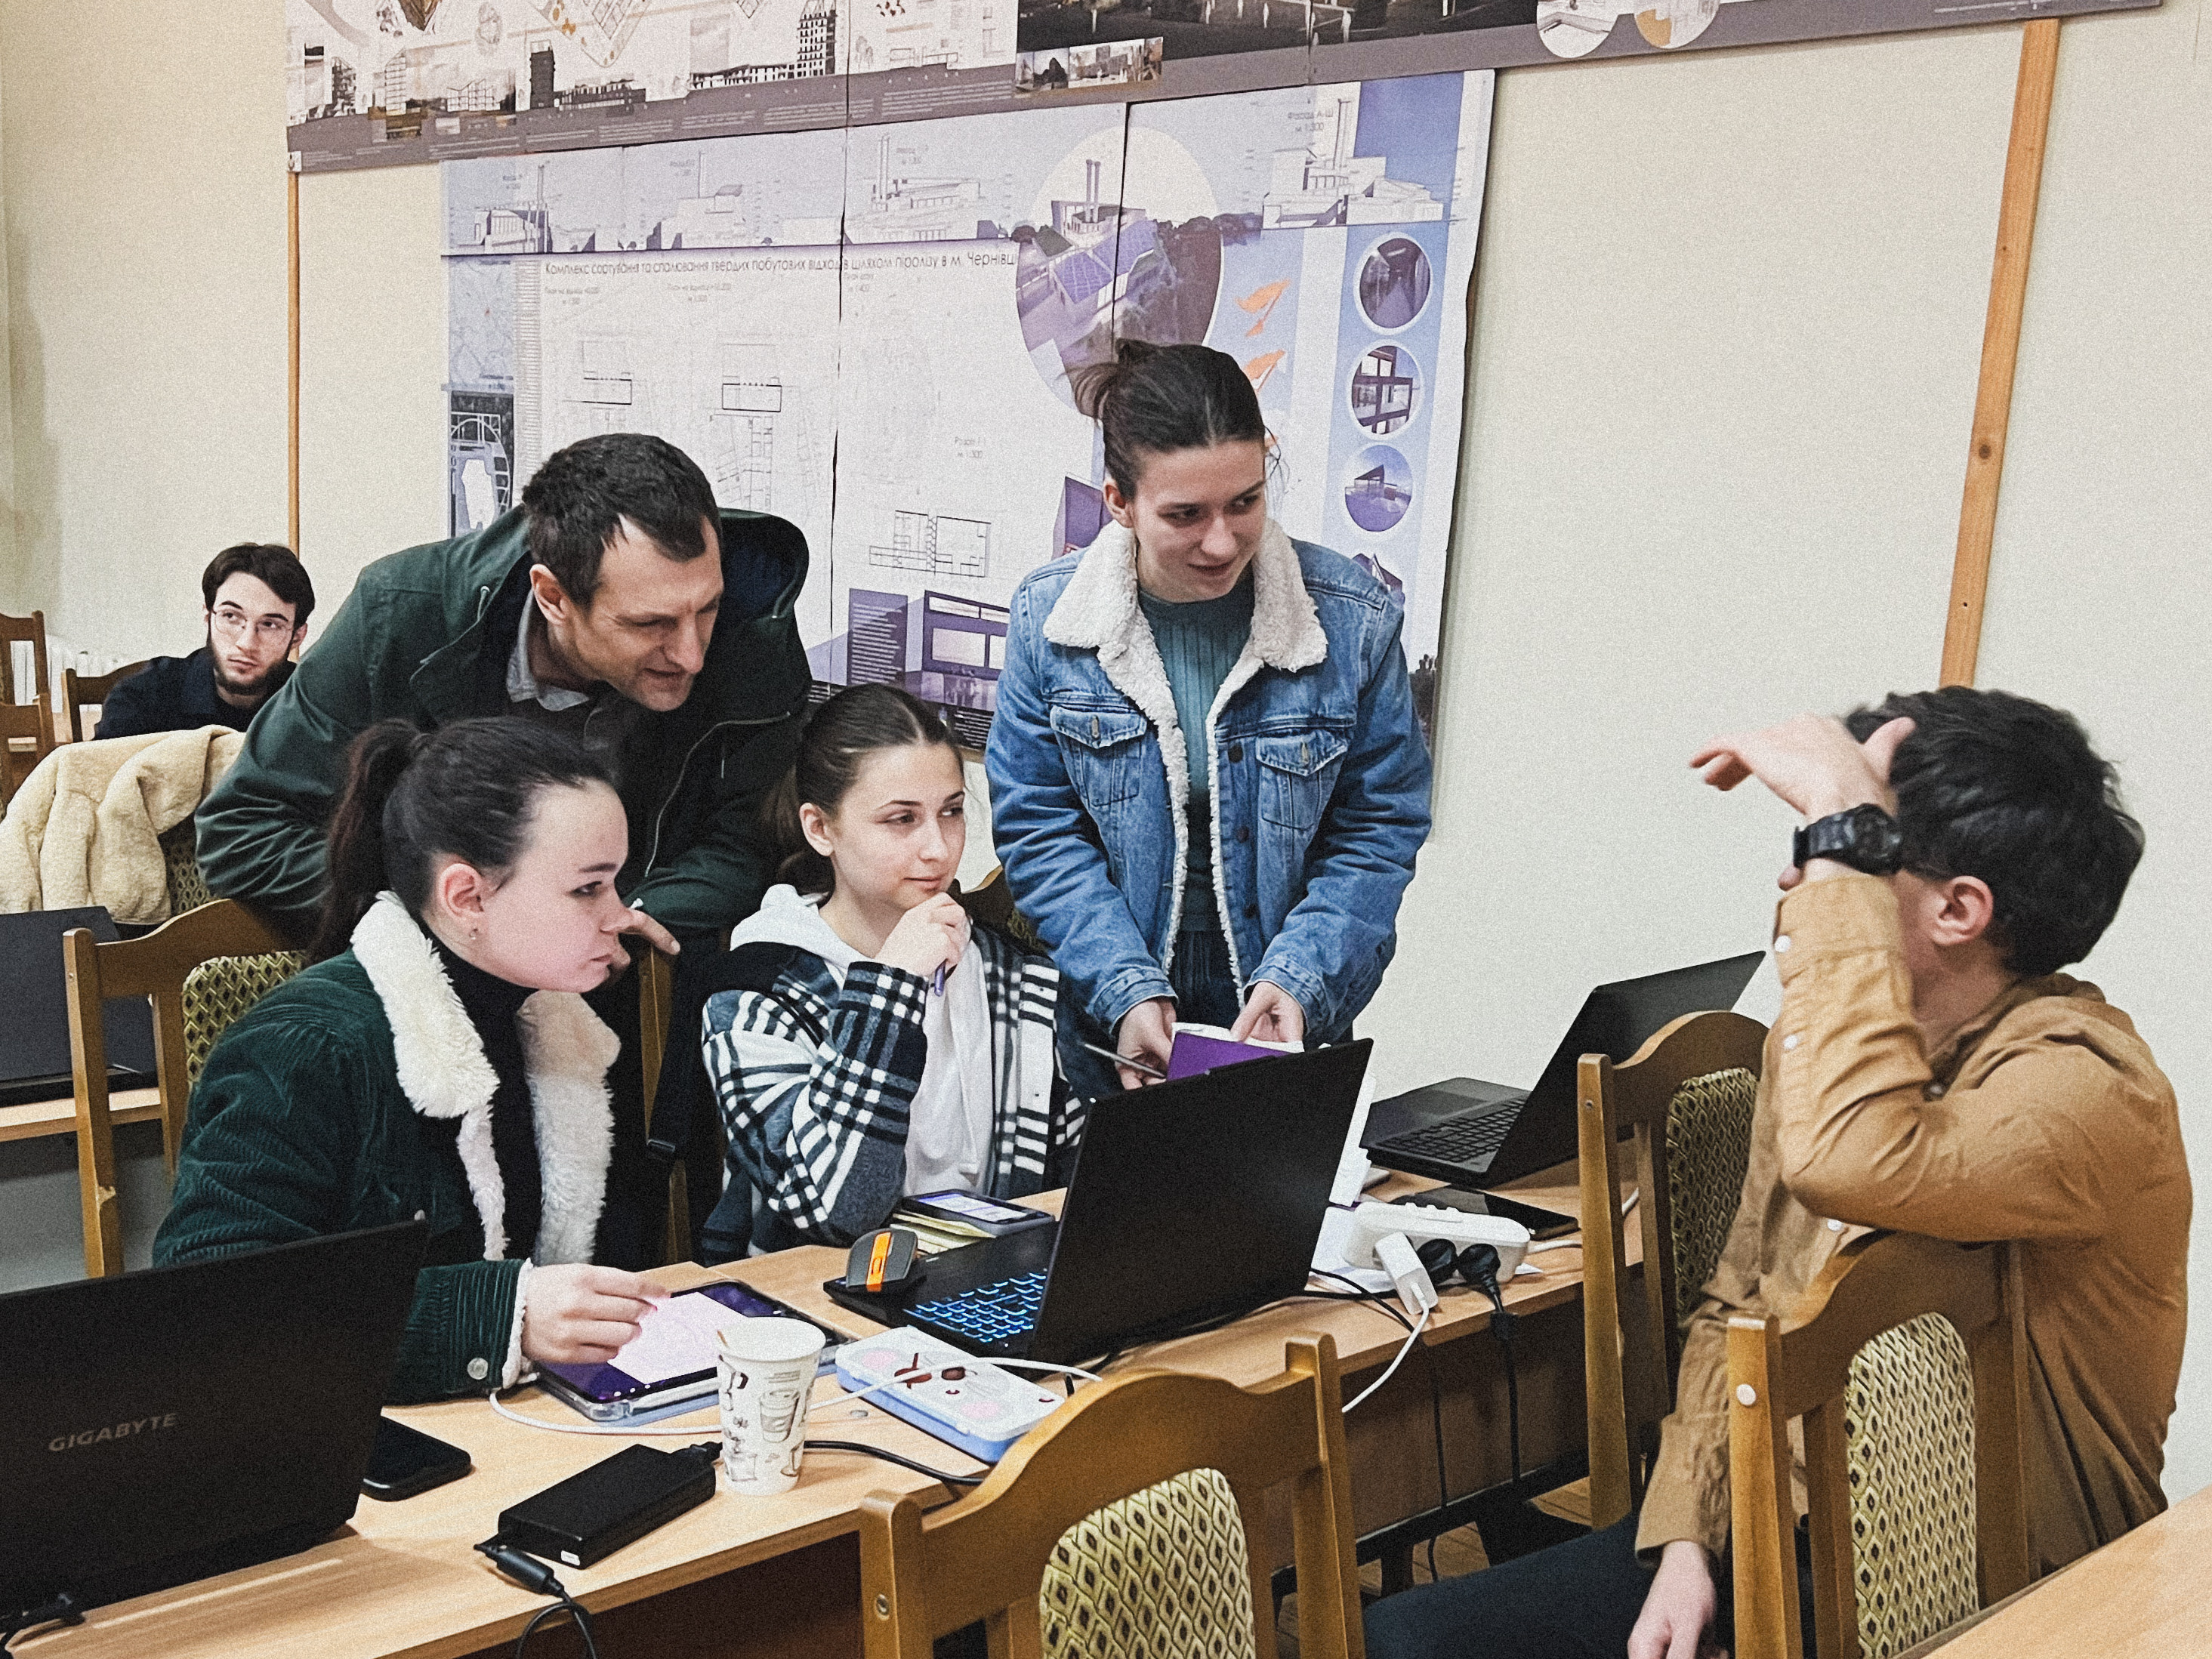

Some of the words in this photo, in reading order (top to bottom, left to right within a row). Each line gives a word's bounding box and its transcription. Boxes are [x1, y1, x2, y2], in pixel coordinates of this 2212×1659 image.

[545, 262, 590, 275] Комплекс
[710, 261, 749, 273] твердих
[752, 257, 806, 273] побутових
[808, 258, 848, 270] відходв
[942, 255, 947, 267] в
[48, 1412, 177, 1452] GIGABYTE
